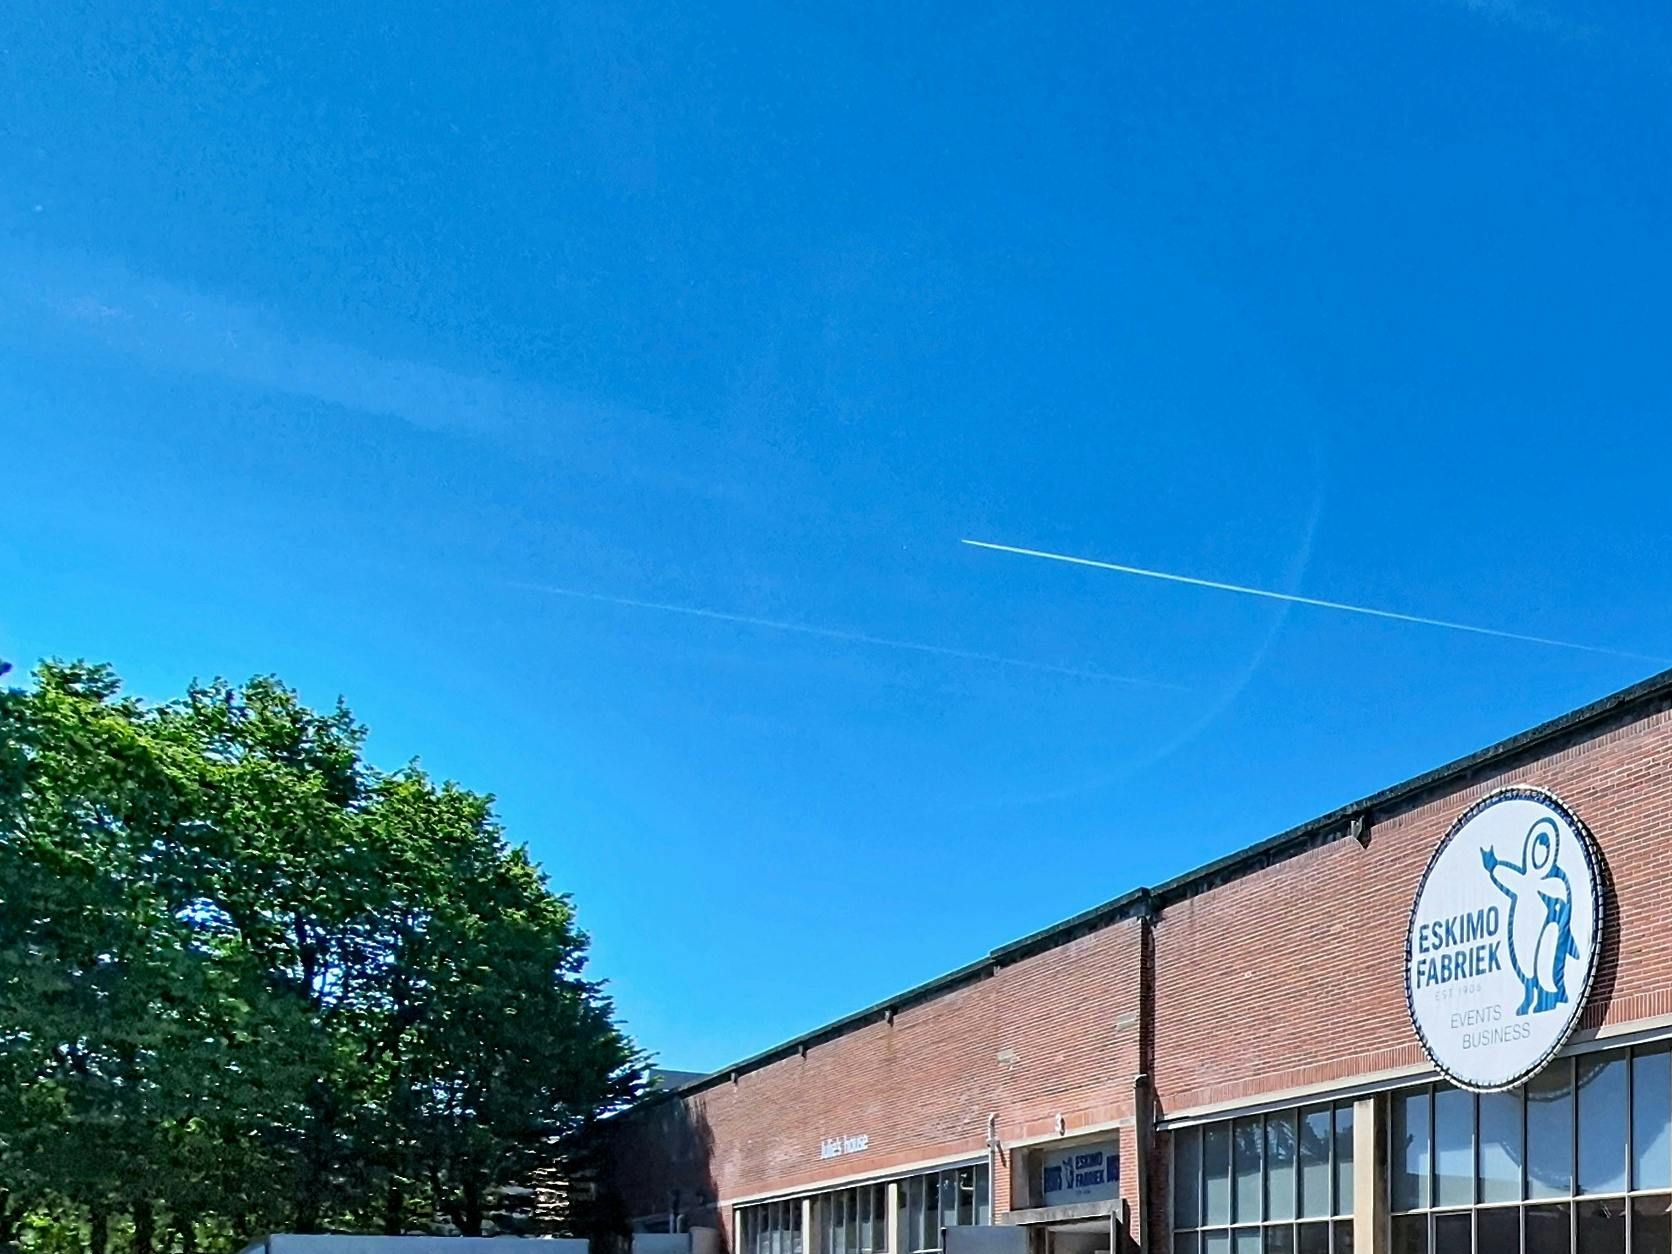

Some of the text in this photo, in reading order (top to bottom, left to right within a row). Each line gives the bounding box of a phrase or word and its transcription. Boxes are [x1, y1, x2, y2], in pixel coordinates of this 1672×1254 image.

[1419, 905, 1499, 954] ESKIMO
[1416, 941, 1502, 989] FABRIEK
[1451, 1004, 1502, 1029] EVENTS
[1463, 1022, 1531, 1049] BUSINESS
